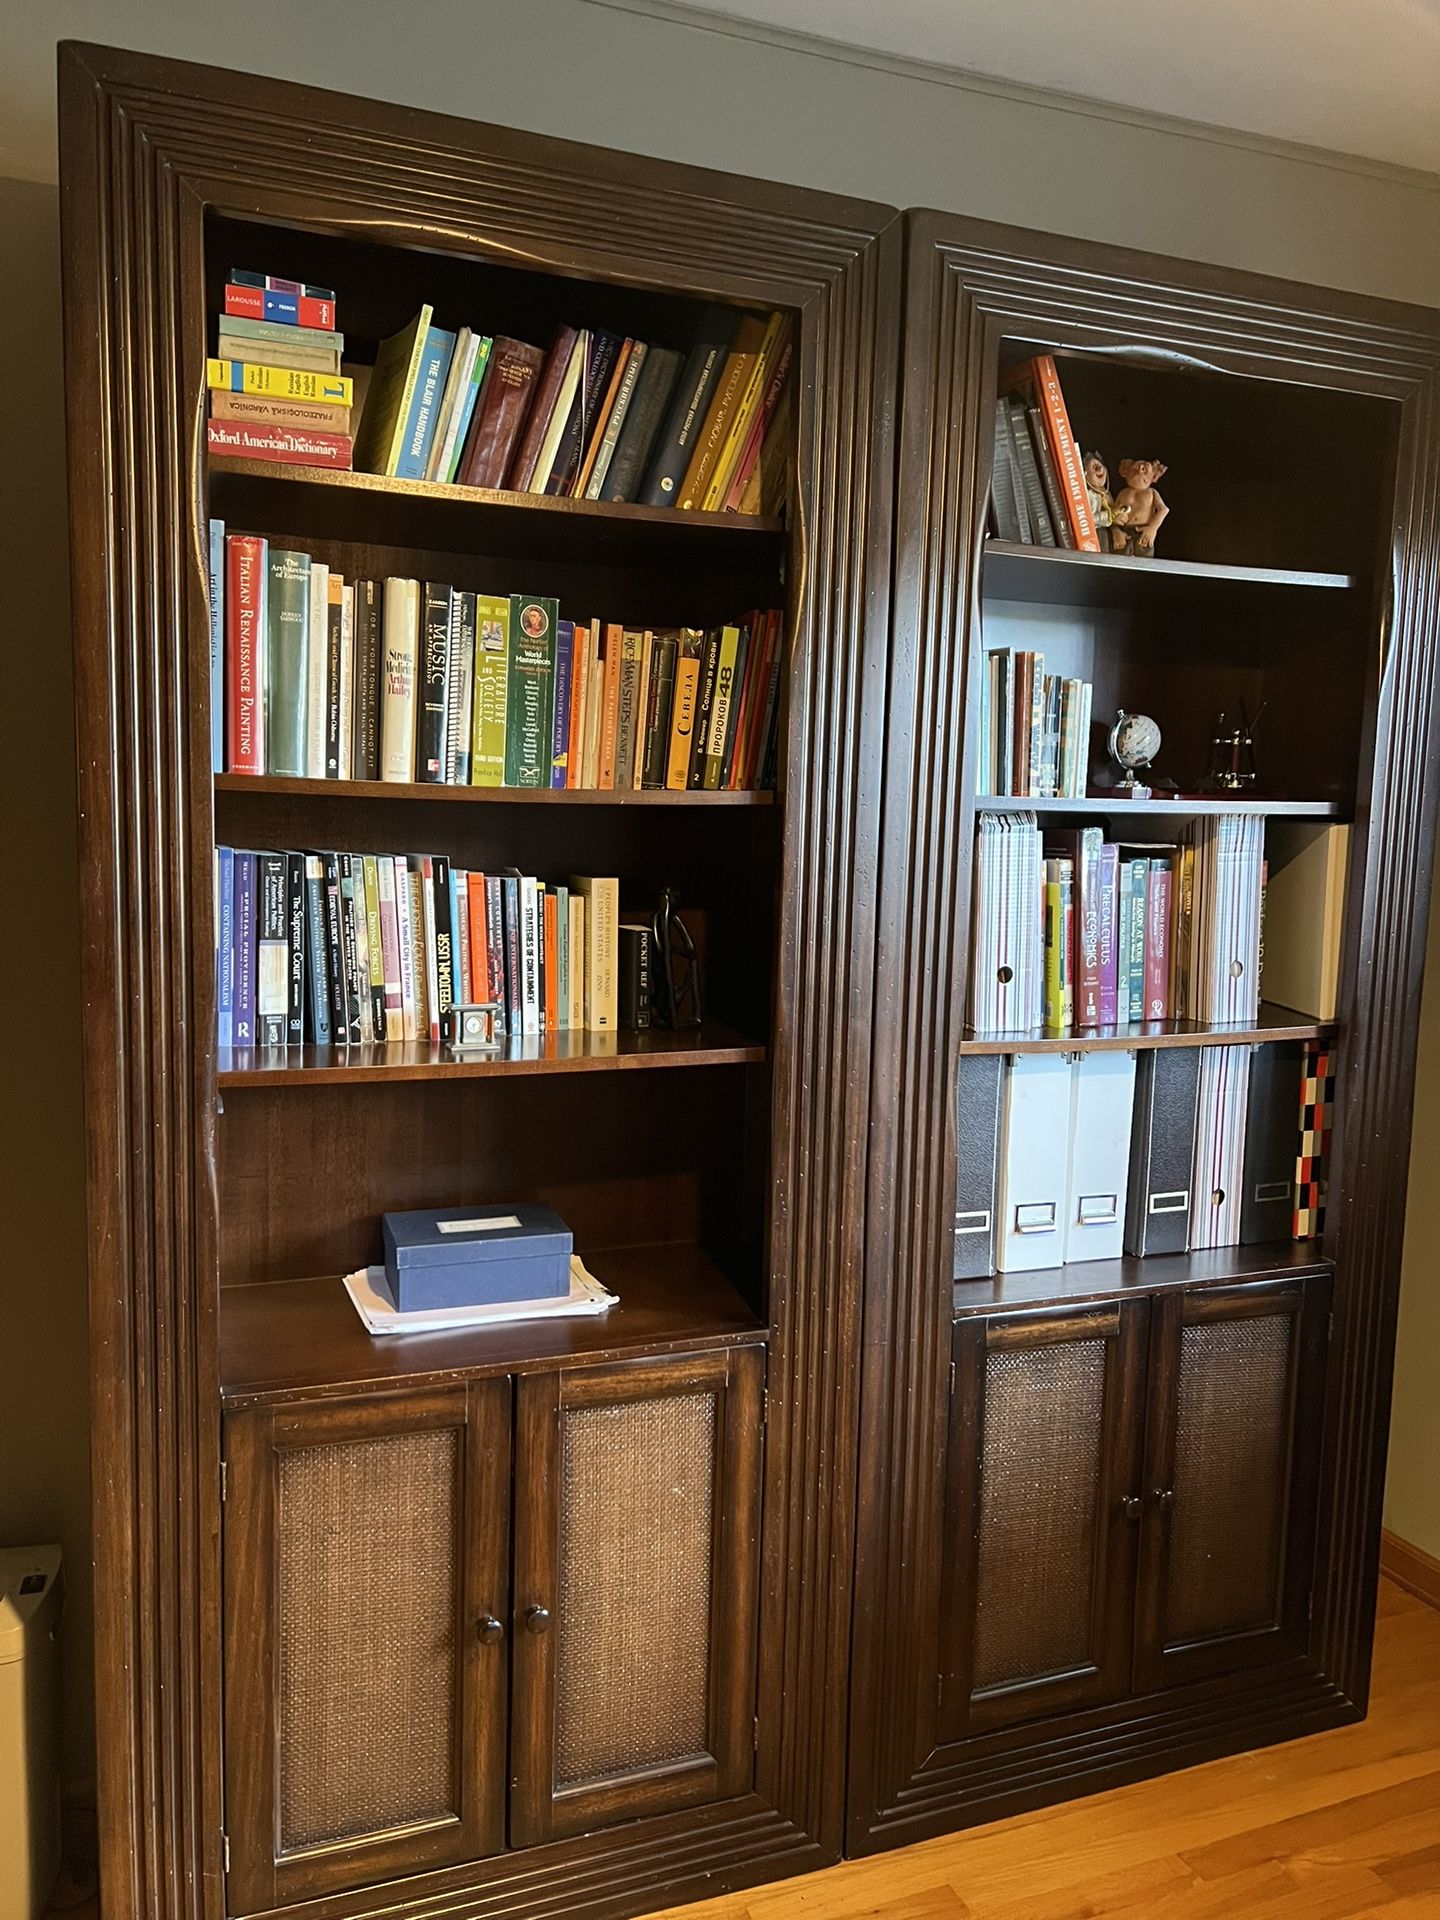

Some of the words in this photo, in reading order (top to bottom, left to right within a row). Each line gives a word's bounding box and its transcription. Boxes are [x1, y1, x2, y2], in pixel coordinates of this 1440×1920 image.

[227, 296, 260, 306] LAROUSSE
[428, 359, 440, 377] THE
[422, 377, 436, 406] BLAIR
[612, 386, 630, 425] РУССКИЙ
[624, 360, 638, 386] ЯЗЫК
[1048, 381, 1062, 413] 1-2-3
[208, 428, 240, 445] Oxford
[242, 432, 288, 450] American
[290, 436, 338, 459] Dictionary
[410, 406, 430, 457] HANDBOOK
[707, 410, 724, 448] СЛОВАРЬ
[1056, 417, 1082, 500] IMPROVEMENT
[1076, 503, 1090, 537] HOME
[275, 571, 284, 579] of
[285, 572, 308, 582] Europe
[285, 558, 299, 567] The
[240, 555, 251, 604] ITALIAN
[240, 608, 252, 692] RENAISSANCE
[370, 633, 375, 642] IN
[431, 623, 446, 685] MUSIC
[516, 655, 551, 665] Masterpieces
[524, 650, 542, 658] World
[621, 636, 636, 687] RICEYMAN
[708, 641, 717, 669] крови
[483, 655, 506, 724] LITERATURE
[701, 678, 712, 711] Солнце
[718, 666, 732, 698] 48
[476, 676, 496, 722] SOCIETY
[620, 689, 632, 723] STEPS
[677, 674, 693, 736] СЕВЕЛА
[240, 697, 252, 755] PAINTING
[556, 716, 562, 725] OF
[698, 719, 707, 746] Фромер
[712, 699, 727, 754] ПРОРОКОВ
[554, 726, 562, 753] POETRY
[618, 725, 627, 765] BENNETT
[694, 773, 699, 781] 2
[327, 885, 338, 920] MEDIEVAL
[410, 878, 419, 895] THE
[368, 911, 377, 944] DRIVING
[411, 896, 421, 940] GHOSTLY
[524, 907, 534, 947] STRATEGIES
[1100, 884, 1113, 965] PRECALCULUS
[1137, 897, 1146, 926] REASON
[222, 904, 230, 952] CONTAINING
[290, 910, 302, 949] Supreme
[330, 921, 338, 944] EUROPE
[438, 933, 449, 954] USSR
[1085, 911, 1099, 968] ECONOMICS
[1137, 929, 1144, 940] AT
[292, 952, 302, 979] Court
[370, 947, 379, 975] FORCES
[401, 947, 409, 962] City
[411, 940, 424, 972] LOVER
[460, 939, 469, 971] POLITICAL
[525, 948, 534, 957] OF
[1136, 942, 1144, 963] WORK
[222, 953, 230, 1005] NATIONALISM
[404, 972, 412, 998] France
[437, 955, 451, 1013] STEELTOWN
[510, 944, 518, 1011] INTERNATIONALISM
[525, 958, 535, 1004] CONTAINMENT
[1121, 975, 1128, 988] 2
